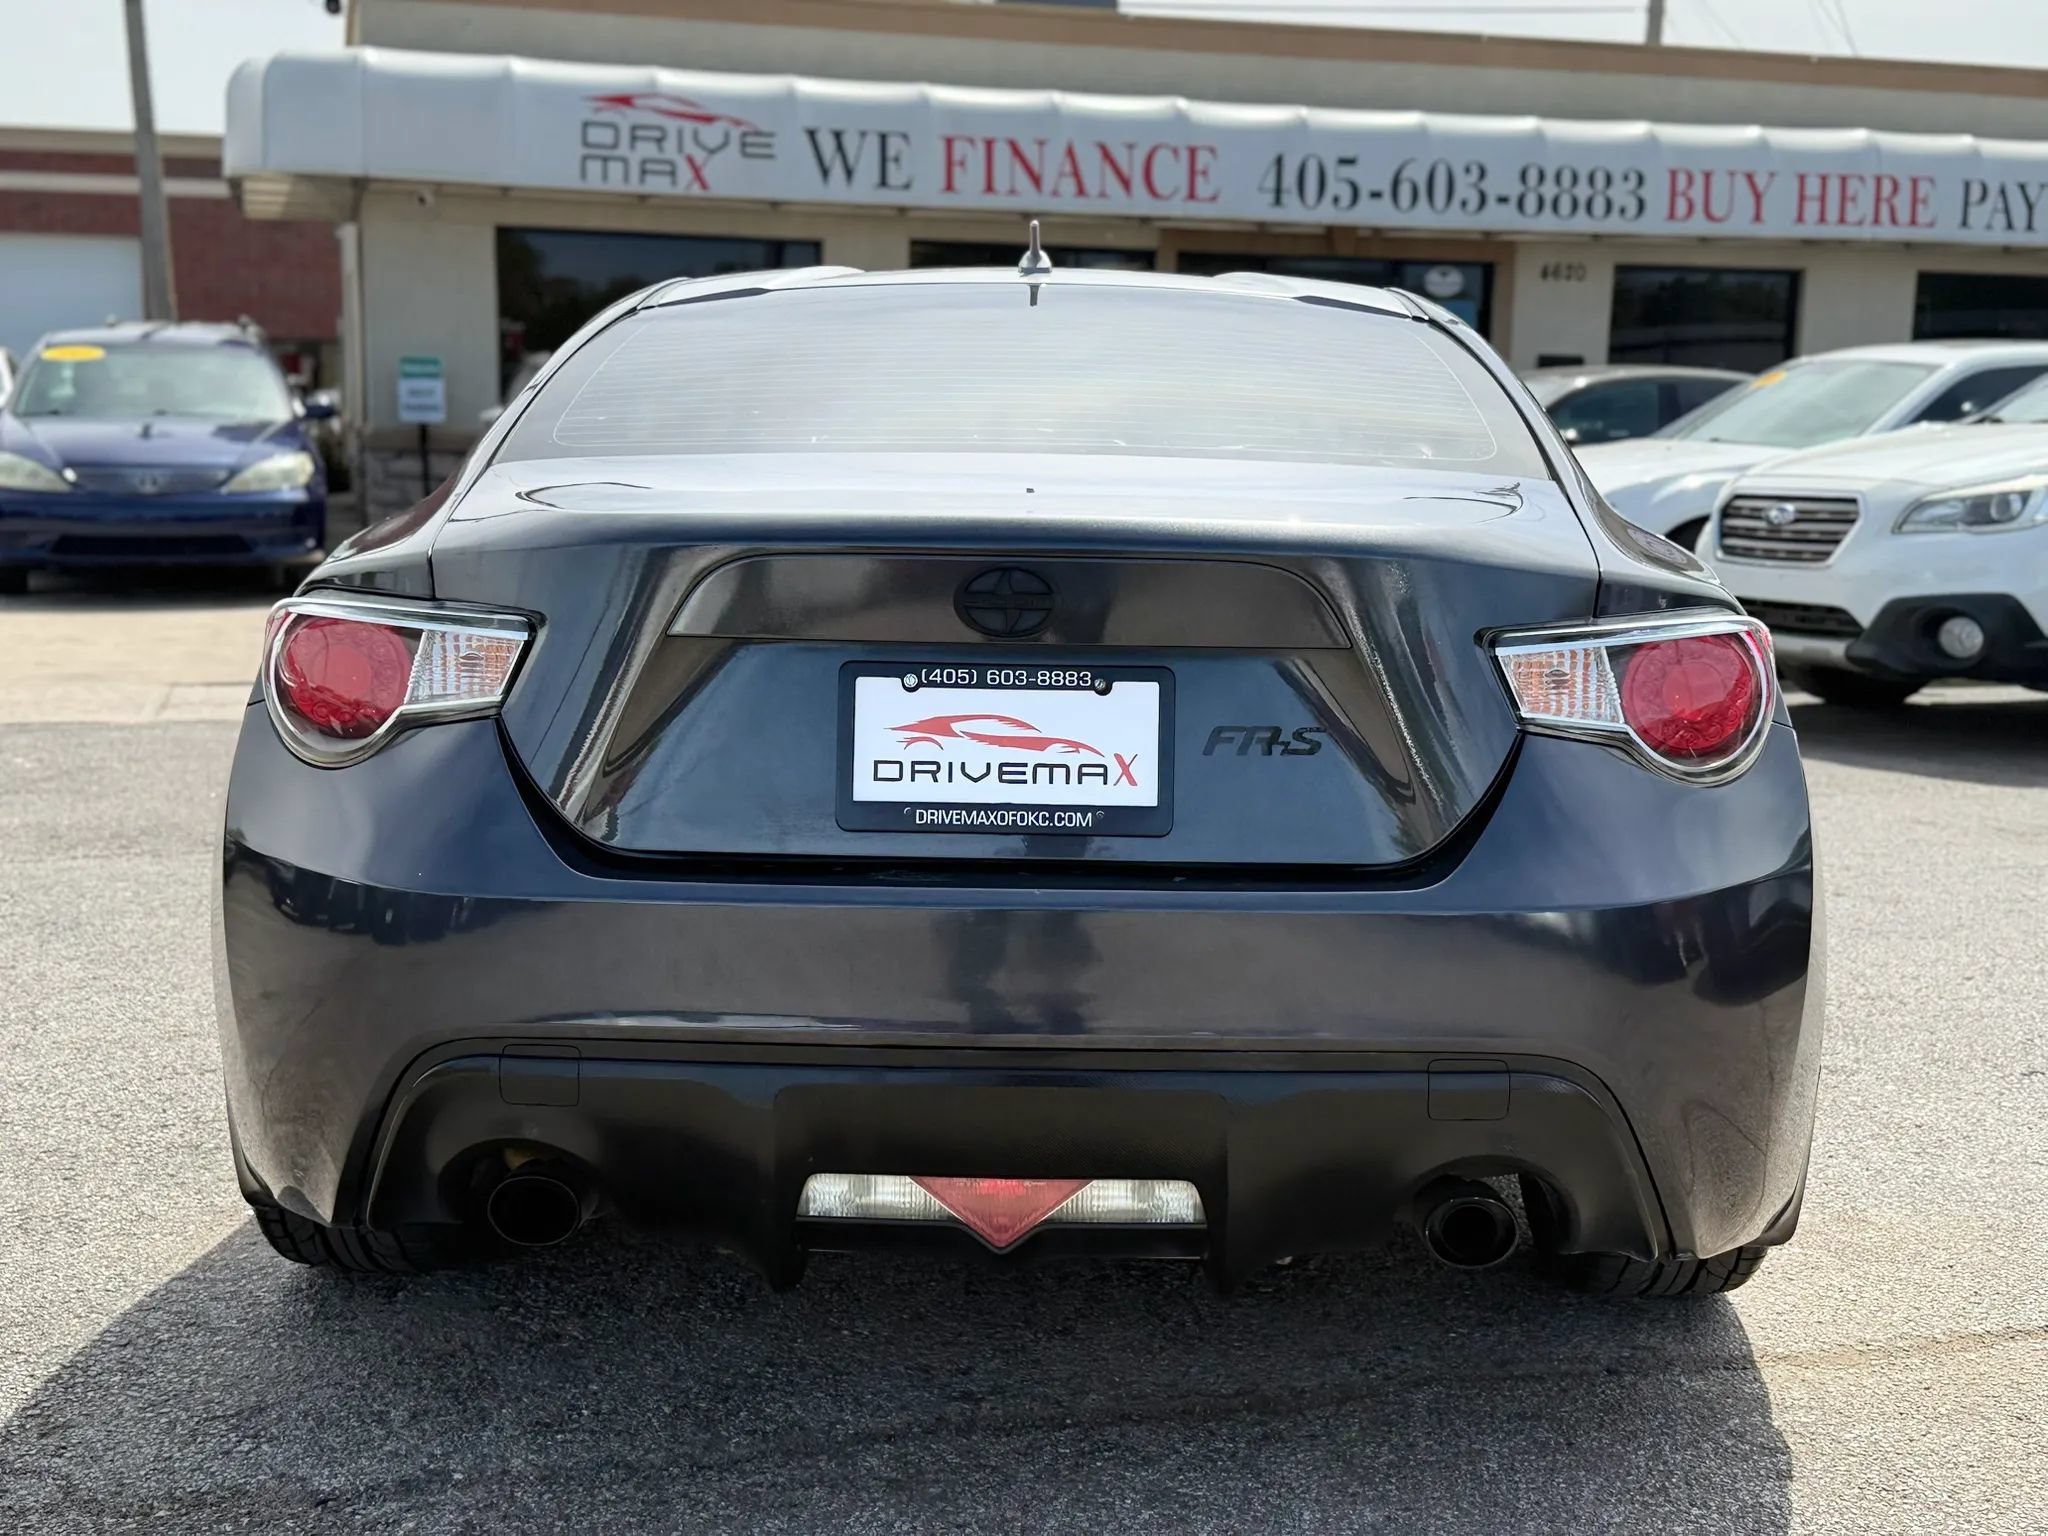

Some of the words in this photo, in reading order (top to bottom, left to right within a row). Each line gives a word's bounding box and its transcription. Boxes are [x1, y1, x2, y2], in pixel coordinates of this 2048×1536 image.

[581, 120, 776, 160] DRIVE
[580, 155, 710, 192] MAX
[803, 127, 912, 191] WE
[939, 134, 1219, 202] FINANCE
[1257, 152, 1646, 224] 405-603-8883
[1665, 166, 1777, 225] BUY
[1794, 172, 1938, 229] HERE
[1960, 178, 2048, 233] PAY
[921, 667, 977, 686] (405)
[986, 670, 1092, 688] 603-8883
[873, 752, 1138, 787] DRIVEMAX
[915, 808, 1093, 828] DRIVEMAXOFOKC.COM
